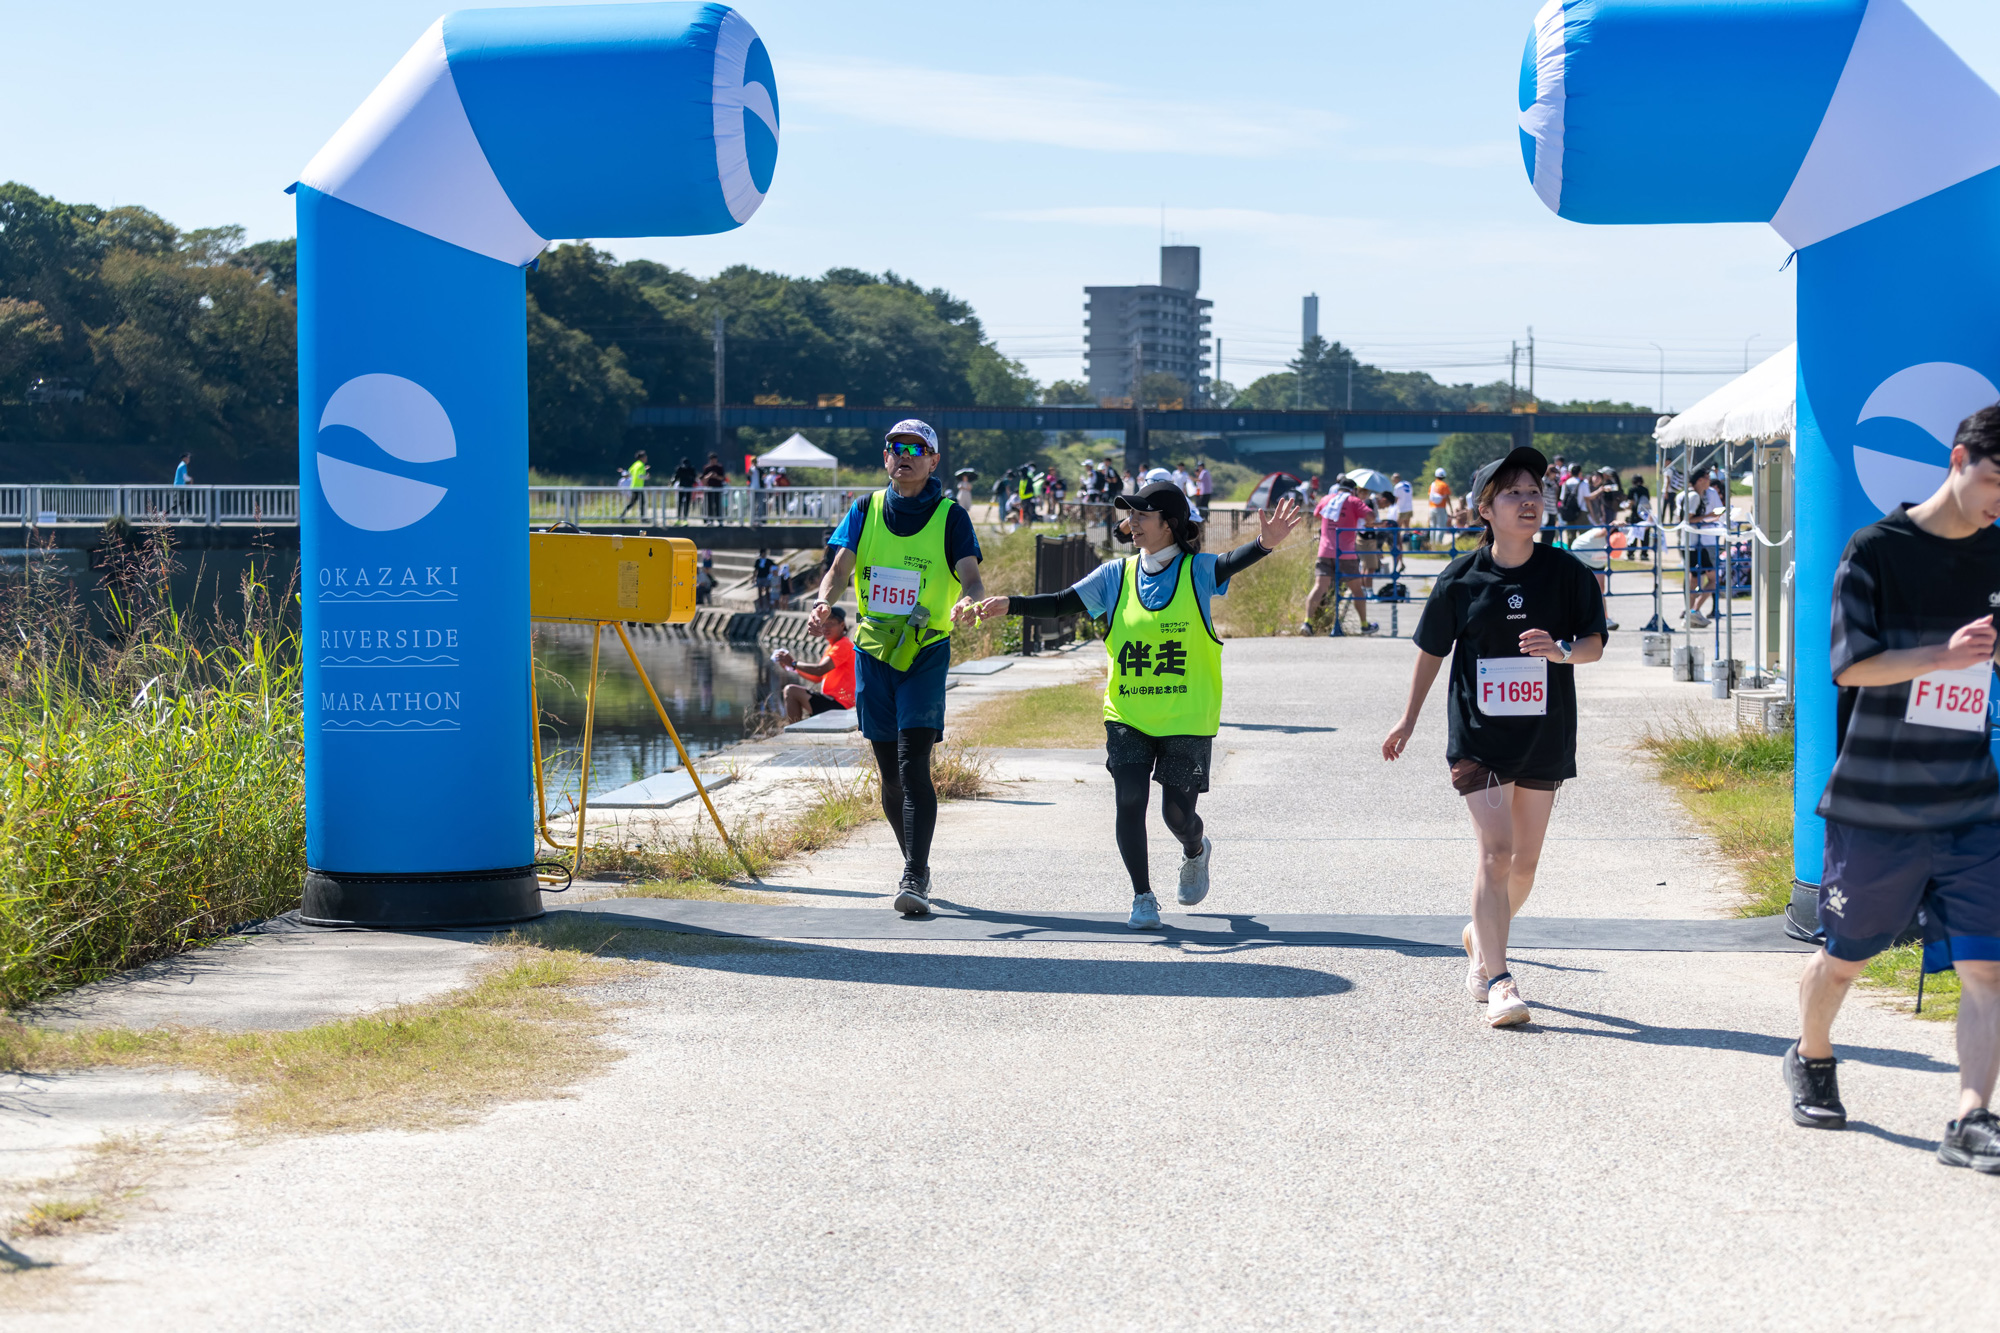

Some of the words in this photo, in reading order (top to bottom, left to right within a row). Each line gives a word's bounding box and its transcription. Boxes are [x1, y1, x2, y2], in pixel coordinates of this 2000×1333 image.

[319, 567, 458, 587] OKAZAKI
[872, 584, 916, 606] F1515
[321, 629, 459, 649] RIVERSIDE
[1117, 639, 1187, 677] 伴走
[321, 691, 461, 711] MARATHON
[1483, 681, 1544, 703] F1695
[1915, 680, 1985, 714] F1528
